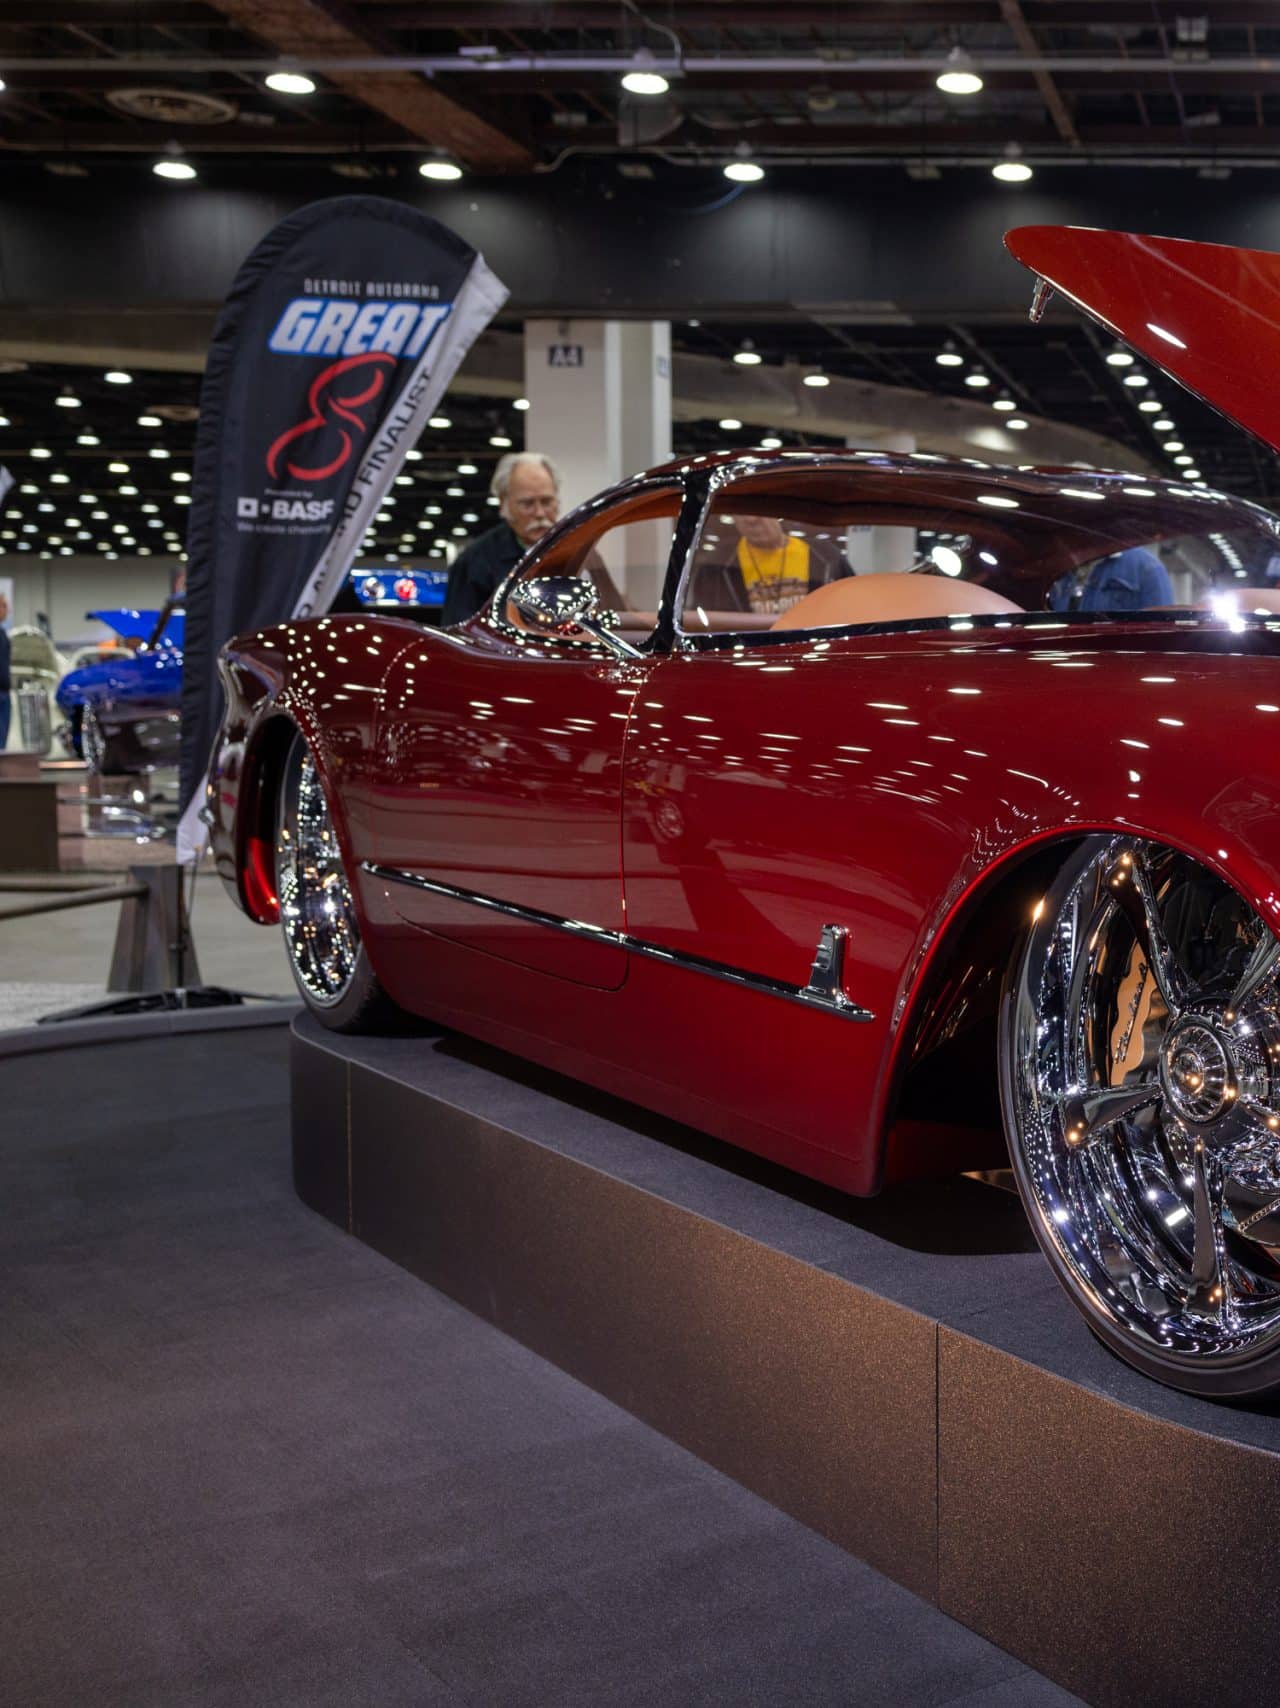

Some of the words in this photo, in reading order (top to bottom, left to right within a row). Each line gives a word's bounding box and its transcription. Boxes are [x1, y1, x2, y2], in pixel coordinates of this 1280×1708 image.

[303, 277, 361, 296] DETROIT
[365, 281, 440, 300] AUTORAMA
[268, 296, 454, 358] GREAT
[358, 365, 433, 486] FINALIST
[271, 498, 336, 521] BASF
